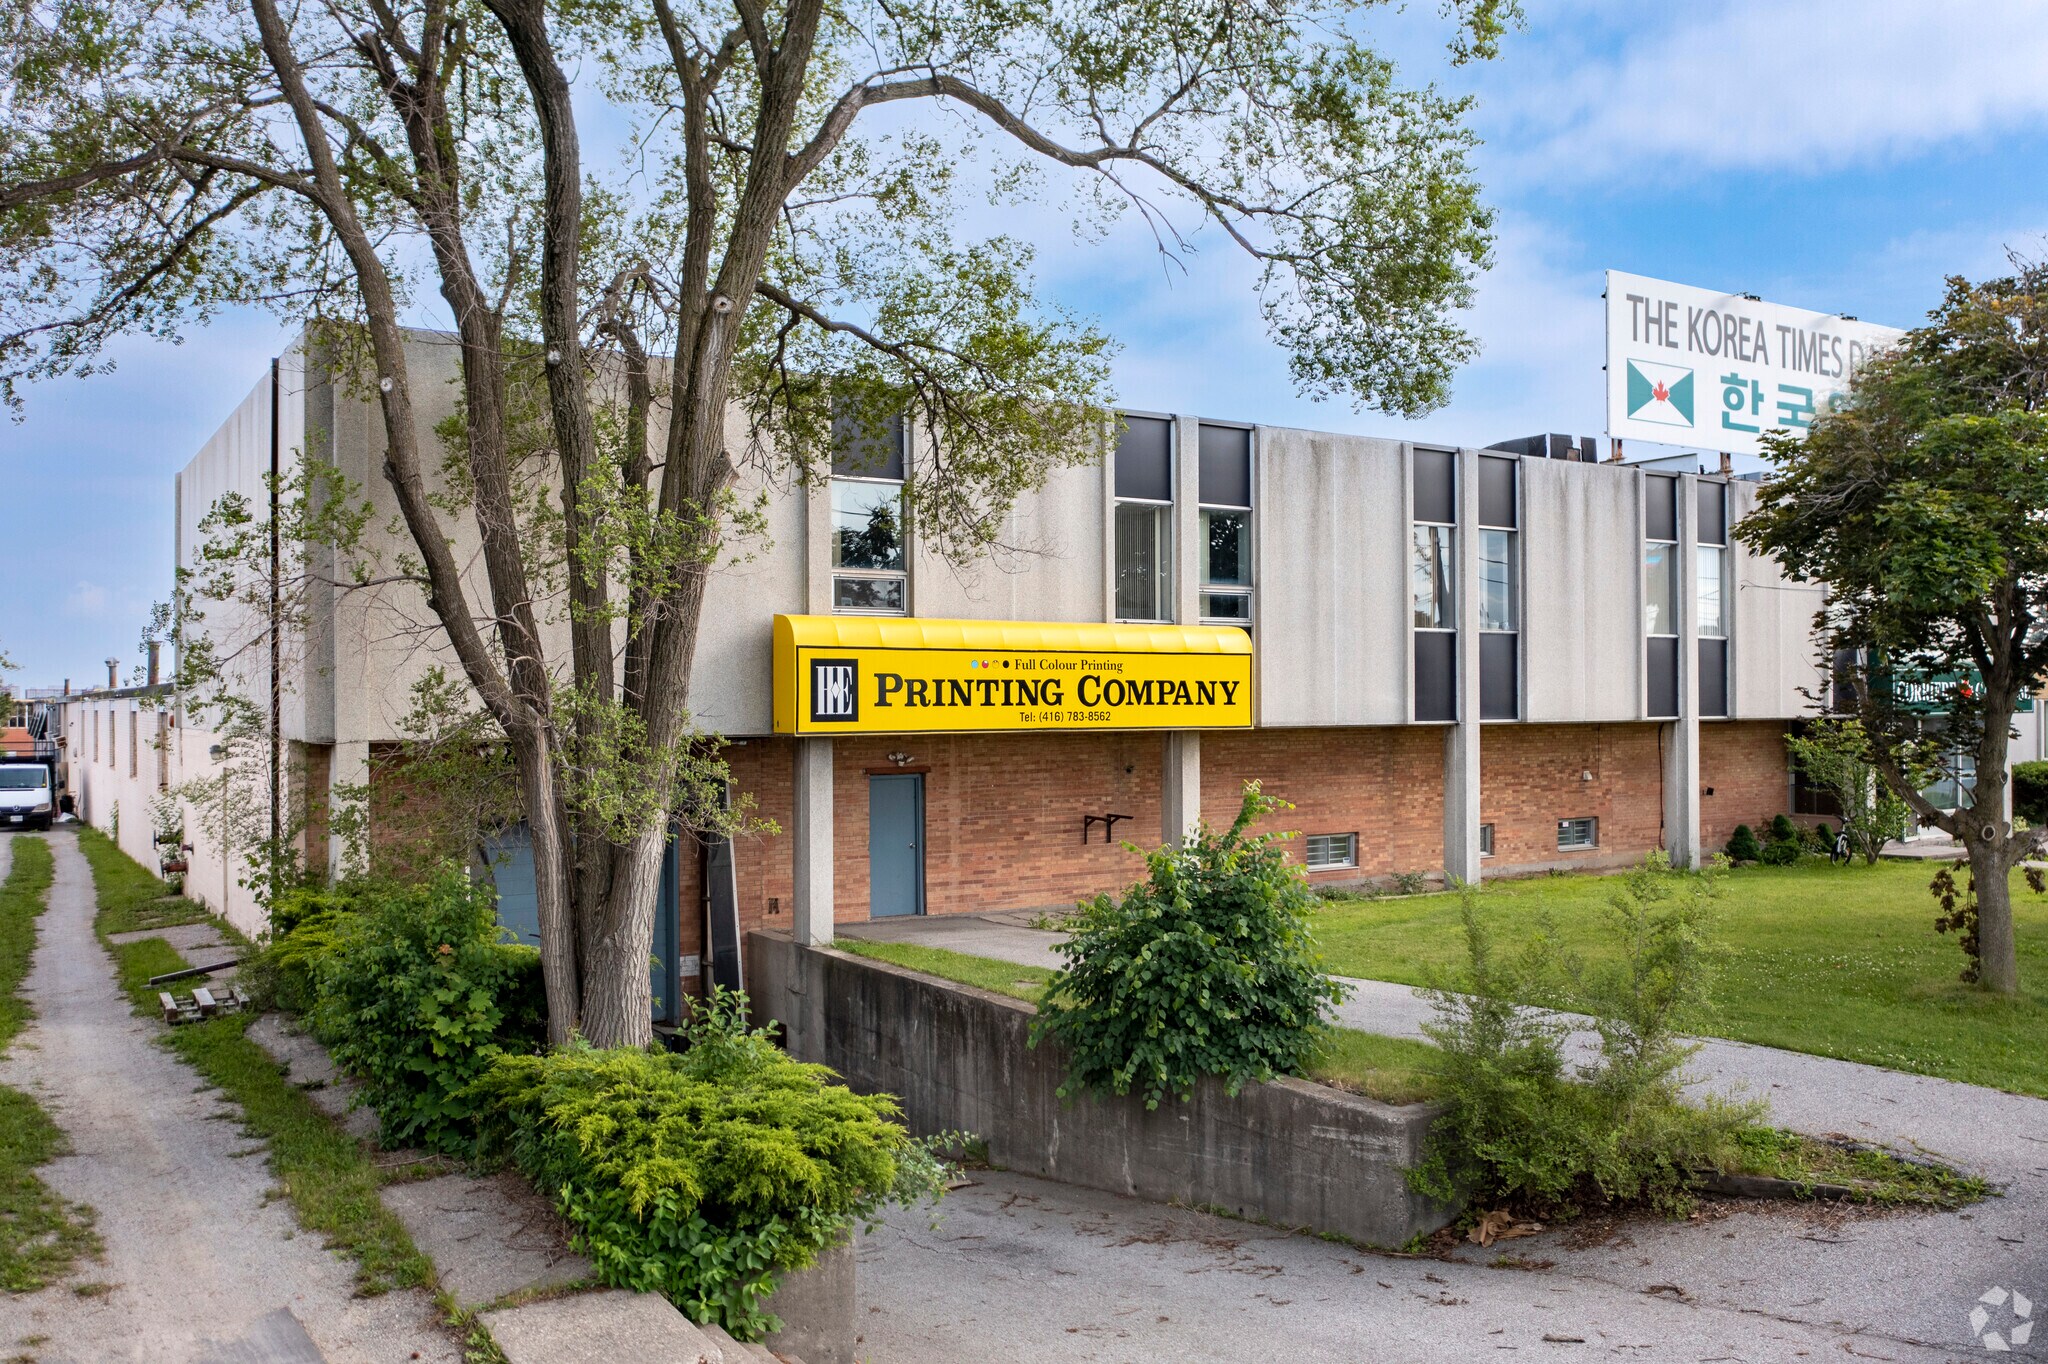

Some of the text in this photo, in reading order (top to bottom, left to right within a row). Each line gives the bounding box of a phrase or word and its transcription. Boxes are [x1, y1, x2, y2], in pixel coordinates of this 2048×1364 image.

[1626, 293, 1679, 350] THE
[1688, 306, 1769, 366] KOREA
[1776, 324, 1843, 379] TIMES
[1014, 658, 1124, 674] Full Colour Printing
[873, 672, 1240, 708] PRINTING COMPANY
[1020, 711, 1111, 723] Tel: (416) 783-8562
